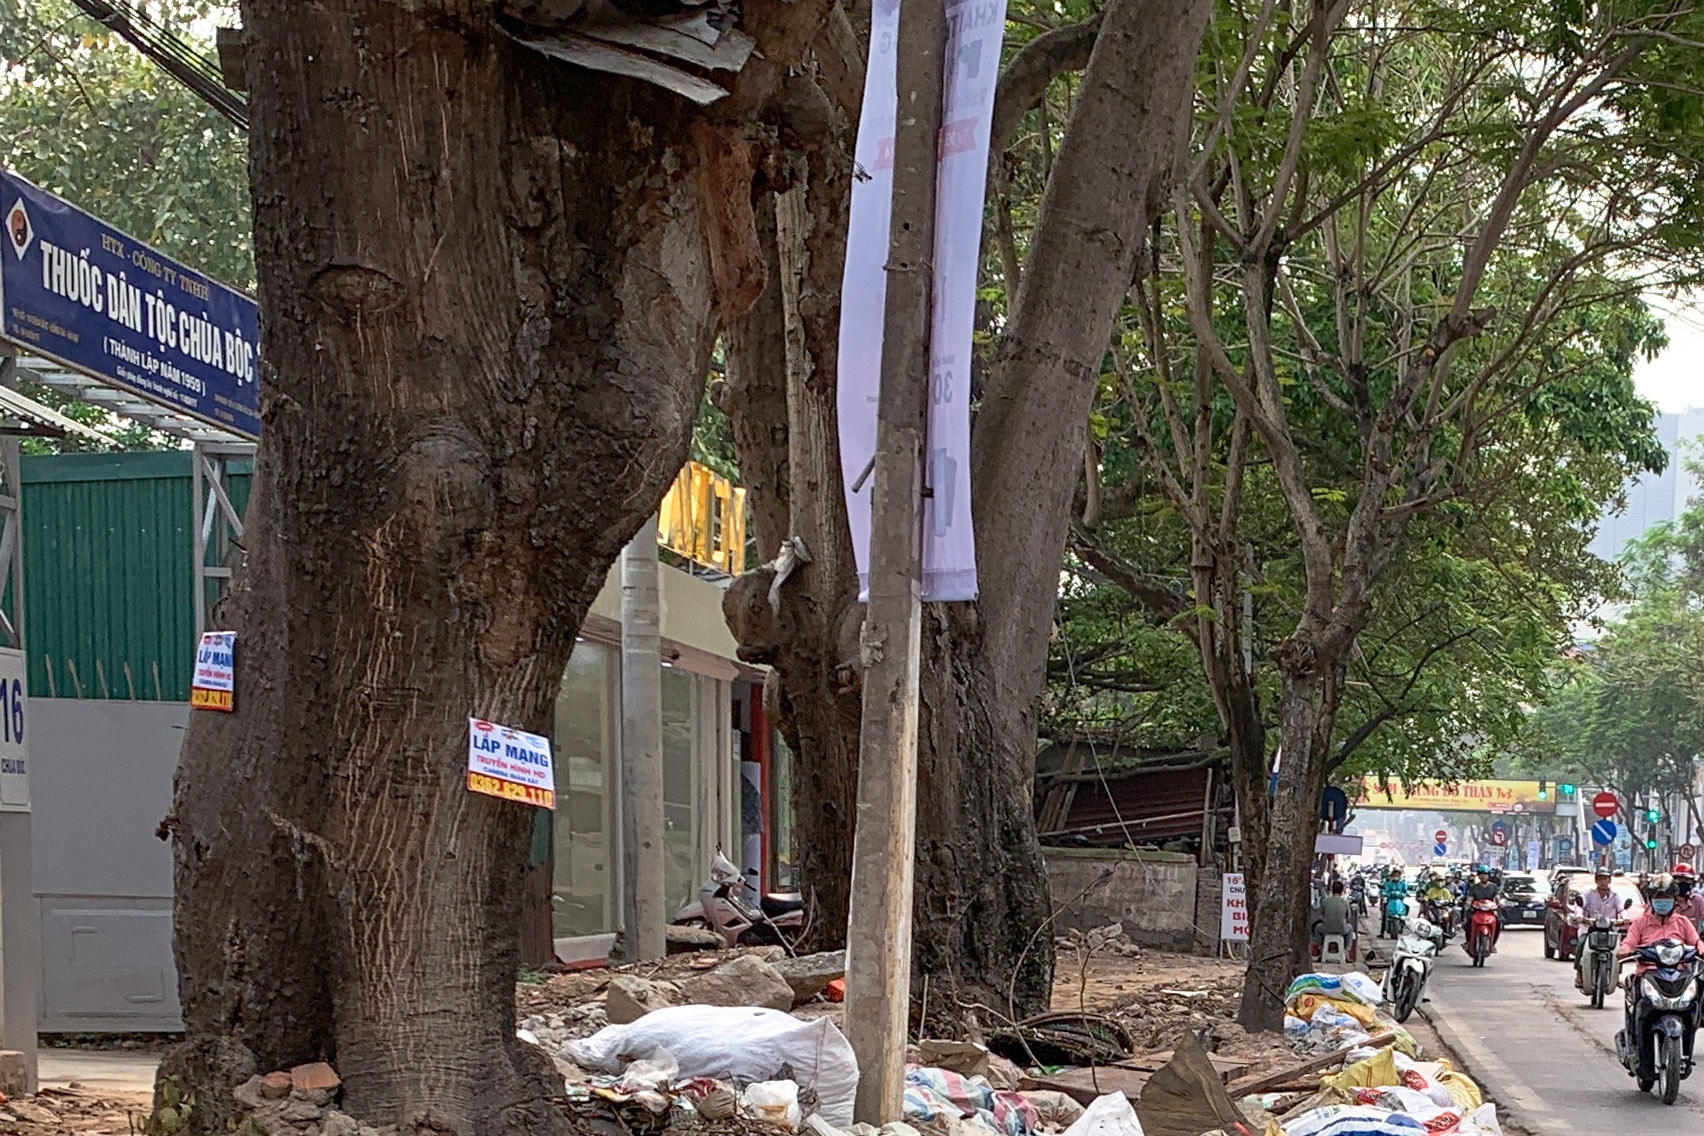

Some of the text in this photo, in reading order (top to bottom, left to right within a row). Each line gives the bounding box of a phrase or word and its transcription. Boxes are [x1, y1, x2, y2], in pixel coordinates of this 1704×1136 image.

[40, 240, 103, 312] THUỐC
[106, 272, 142, 333] DÂN
[145, 289, 177, 352] TỘC
[179, 311, 223, 370] CHÙA
[225, 328, 254, 386] BỘC
[473, 733, 548, 768] LẮP MẠNG
